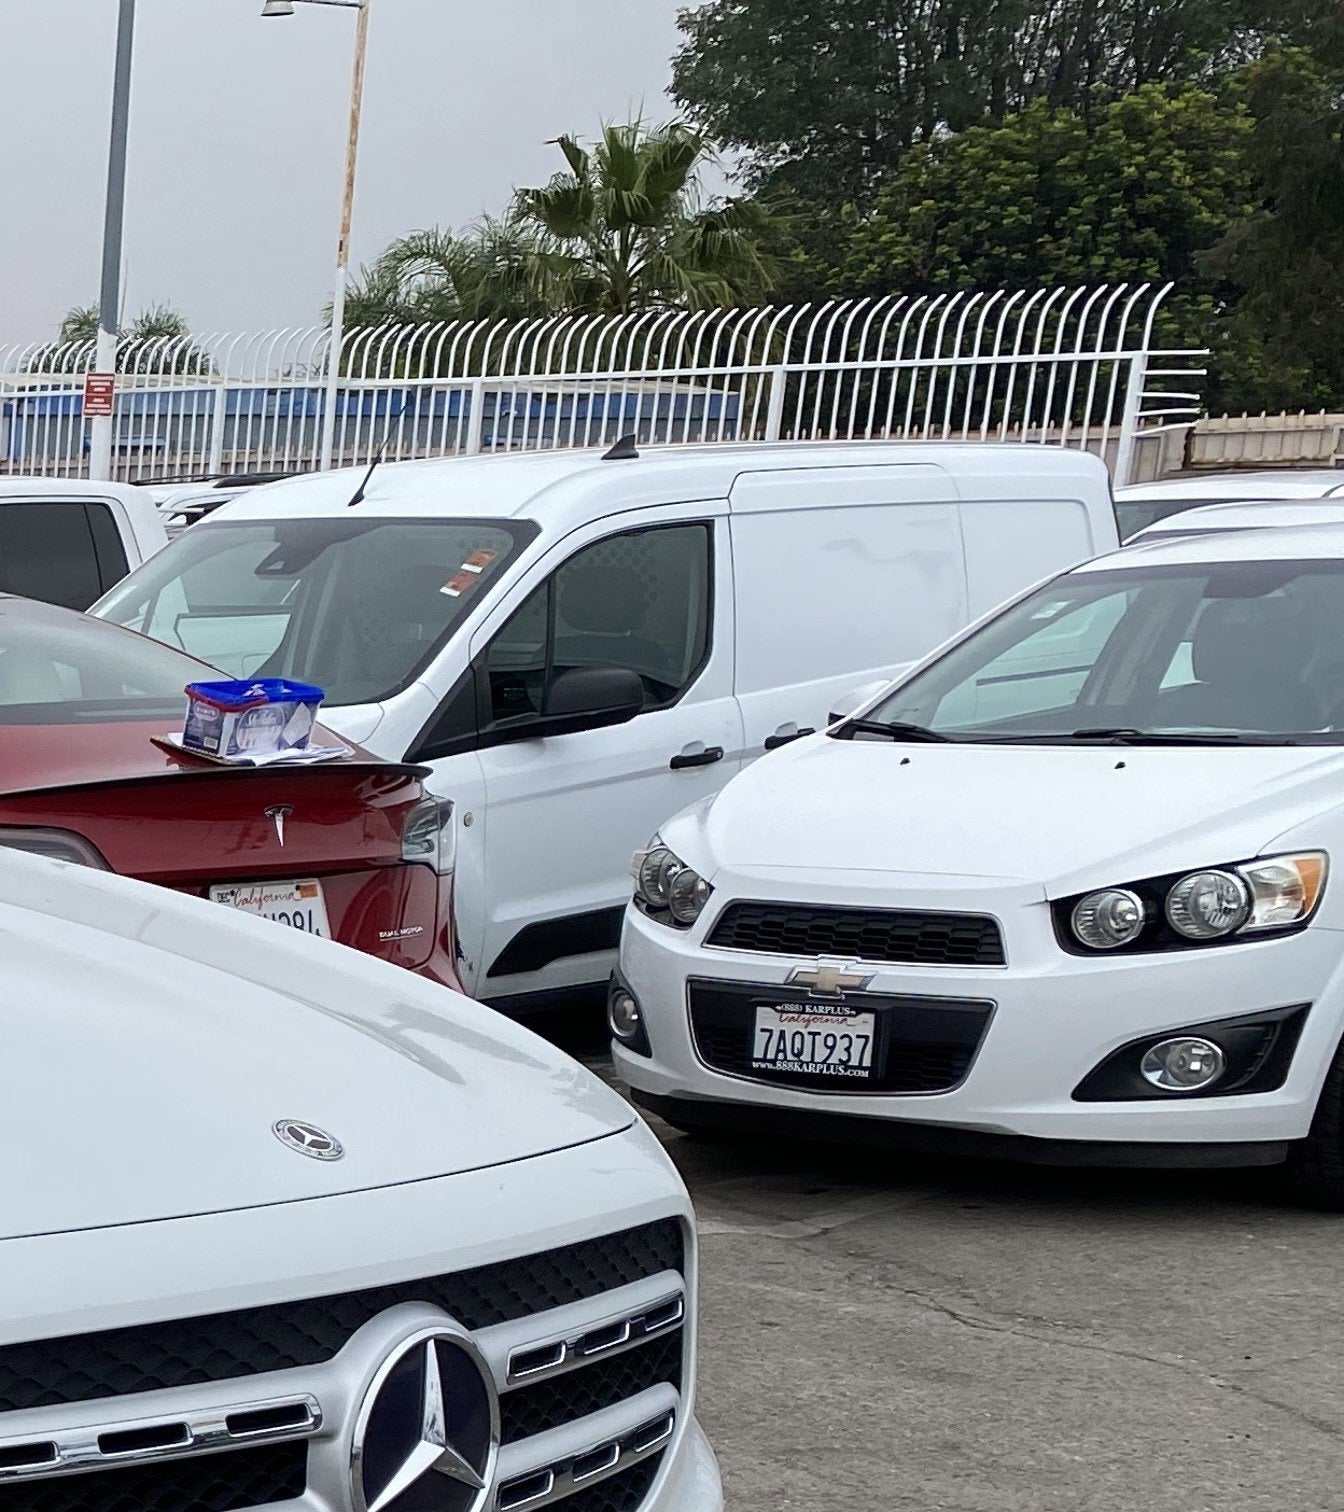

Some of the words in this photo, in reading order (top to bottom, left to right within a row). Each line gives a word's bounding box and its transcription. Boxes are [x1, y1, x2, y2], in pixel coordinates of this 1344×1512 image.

[233, 886, 296, 910] California
[781, 1004, 803, 1013] (888)
[805, 1005, 850, 1015] KARPLUS
[779, 1013, 849, 1029] California
[760, 1028, 870, 1067] 7AQT937
